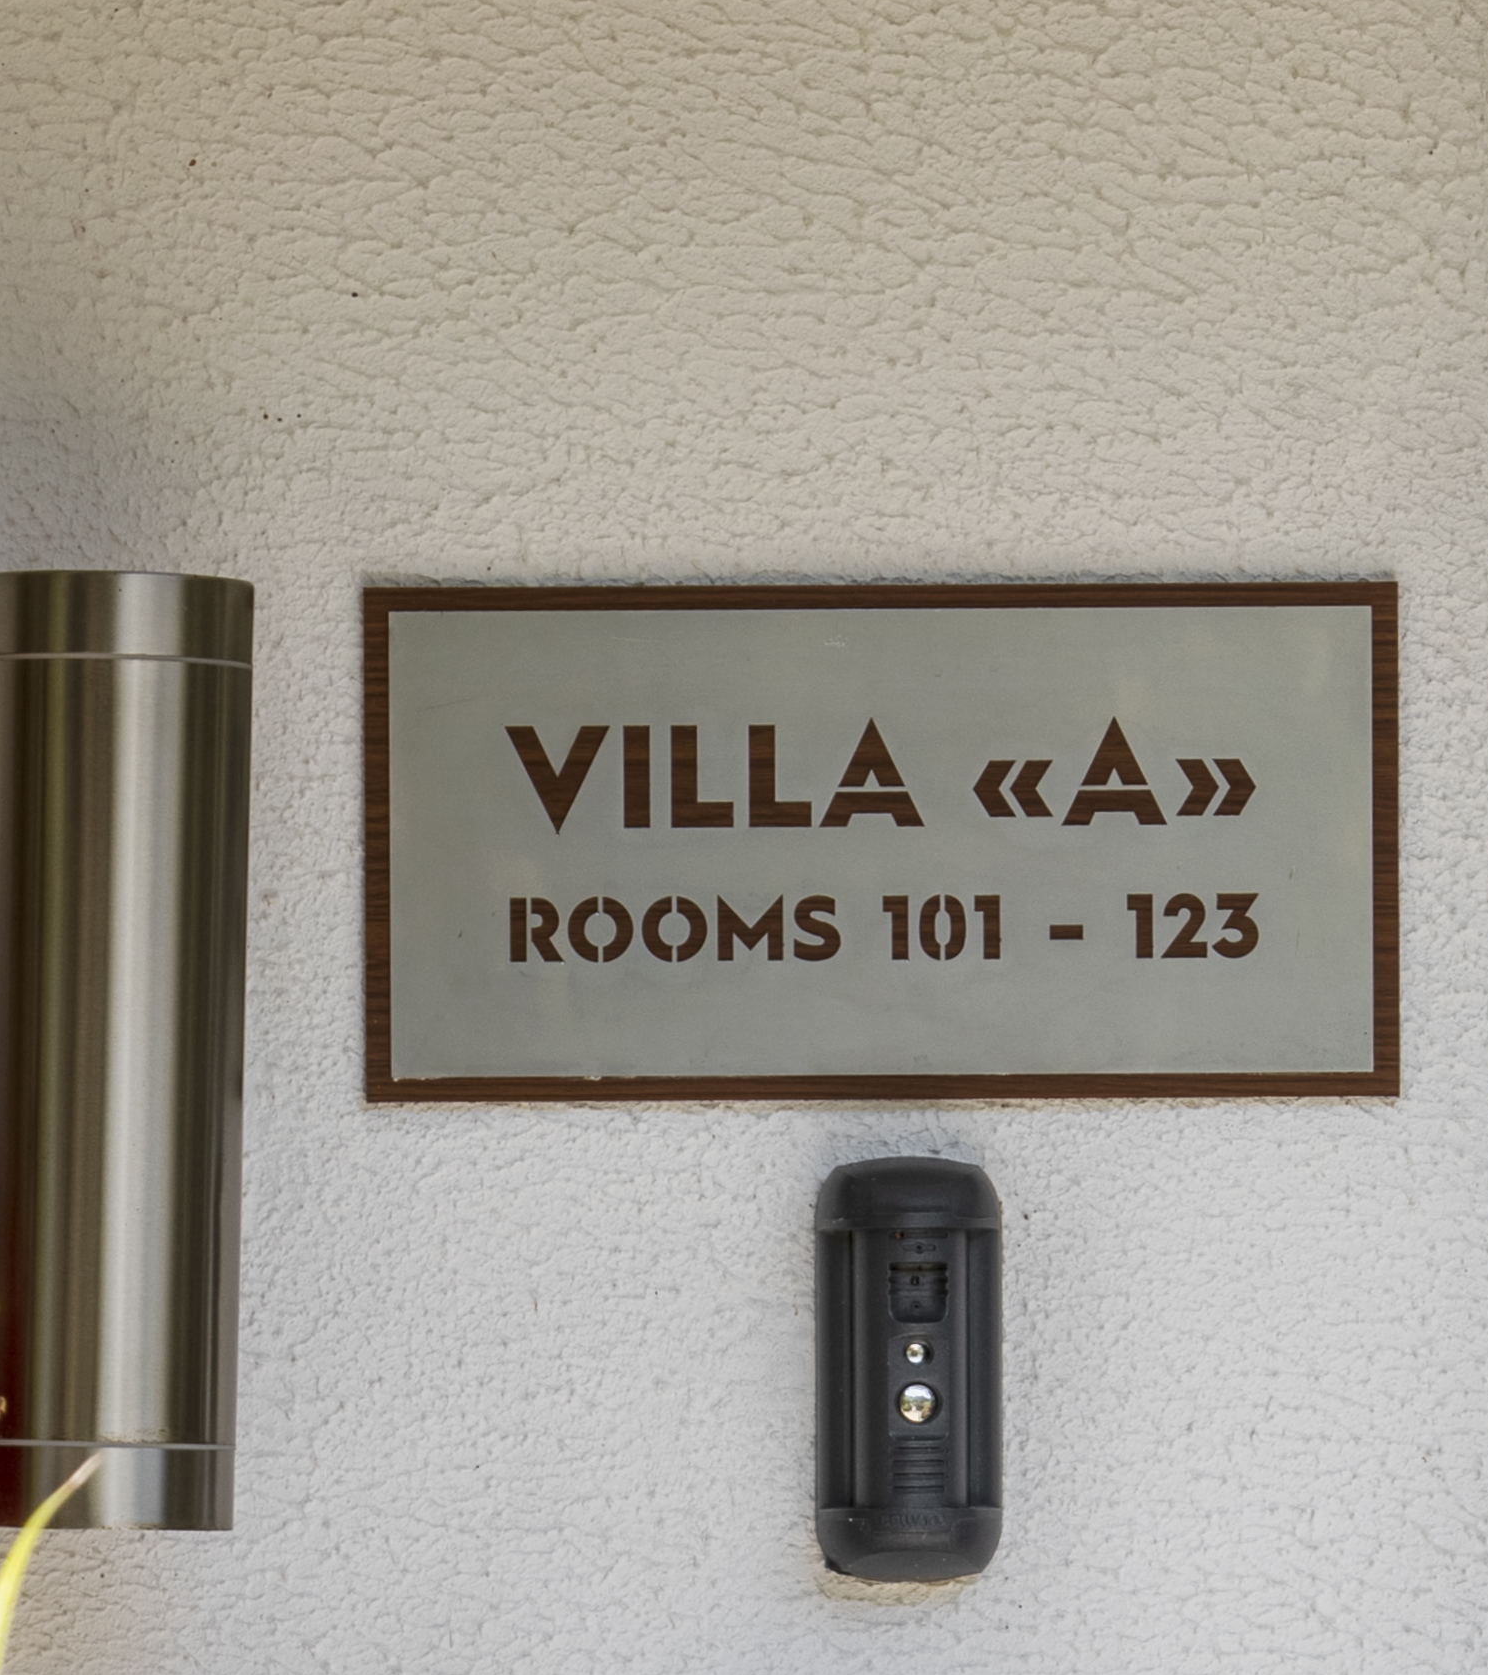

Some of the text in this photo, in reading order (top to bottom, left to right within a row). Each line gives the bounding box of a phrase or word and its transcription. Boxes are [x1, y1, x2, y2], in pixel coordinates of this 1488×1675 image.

[504, 716, 1257, 835] VILLA «A»
[509, 892, 1259, 963] ROOMS 101 - 123
